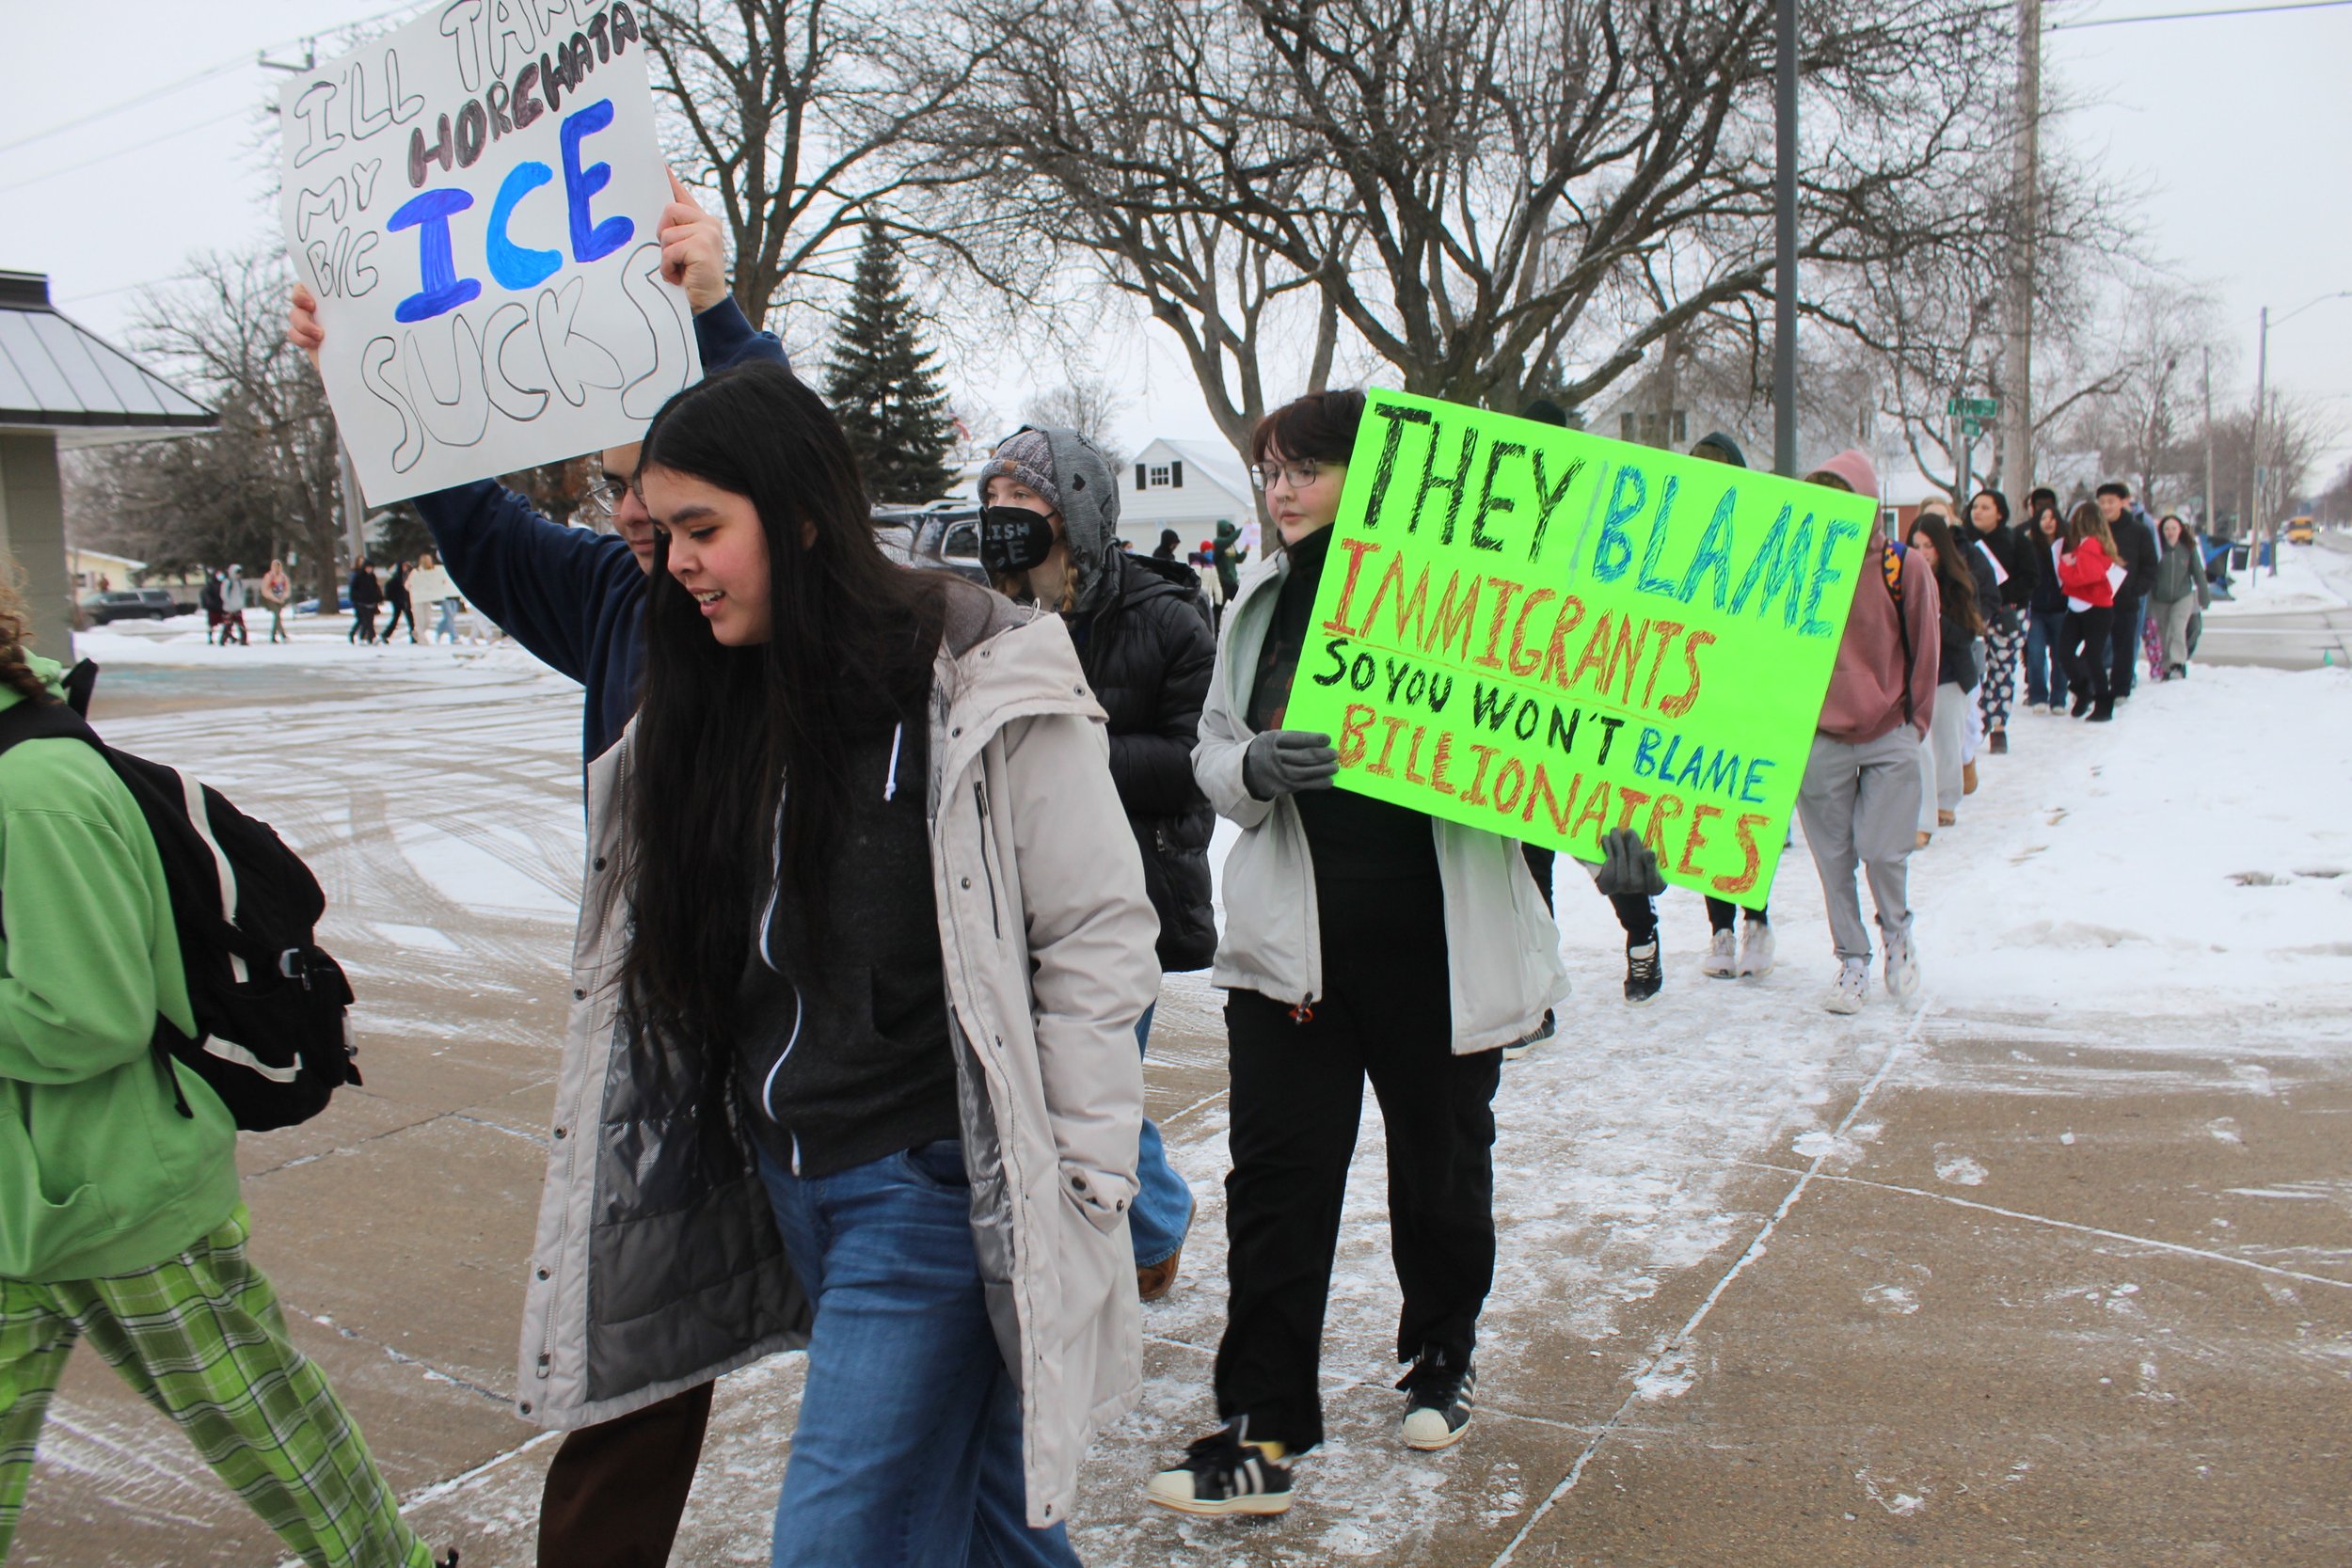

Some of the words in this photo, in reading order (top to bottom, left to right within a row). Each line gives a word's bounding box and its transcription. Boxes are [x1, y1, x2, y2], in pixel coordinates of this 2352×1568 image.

[294, 49, 425, 168] I'LL
[297, 158, 382, 242] MY
[407, 0, 640, 188] HORCHATA
[307, 227, 379, 298] BIG
[387, 98, 635, 324] ICE
[361, 242, 690, 474] SUCKS
[1362, 402, 1586, 563] THEY
[1592, 464, 1861, 639] BLAME
[1313, 638, 1375, 691] SO
[1384, 657, 1453, 713] YOU
[1472, 681, 1625, 766] WON'T
[1634, 727, 1776, 804] BLAME
[1321, 538, 1718, 719] IMMIGRANTS
[1336, 703, 1772, 895] BILLIONAIRES
